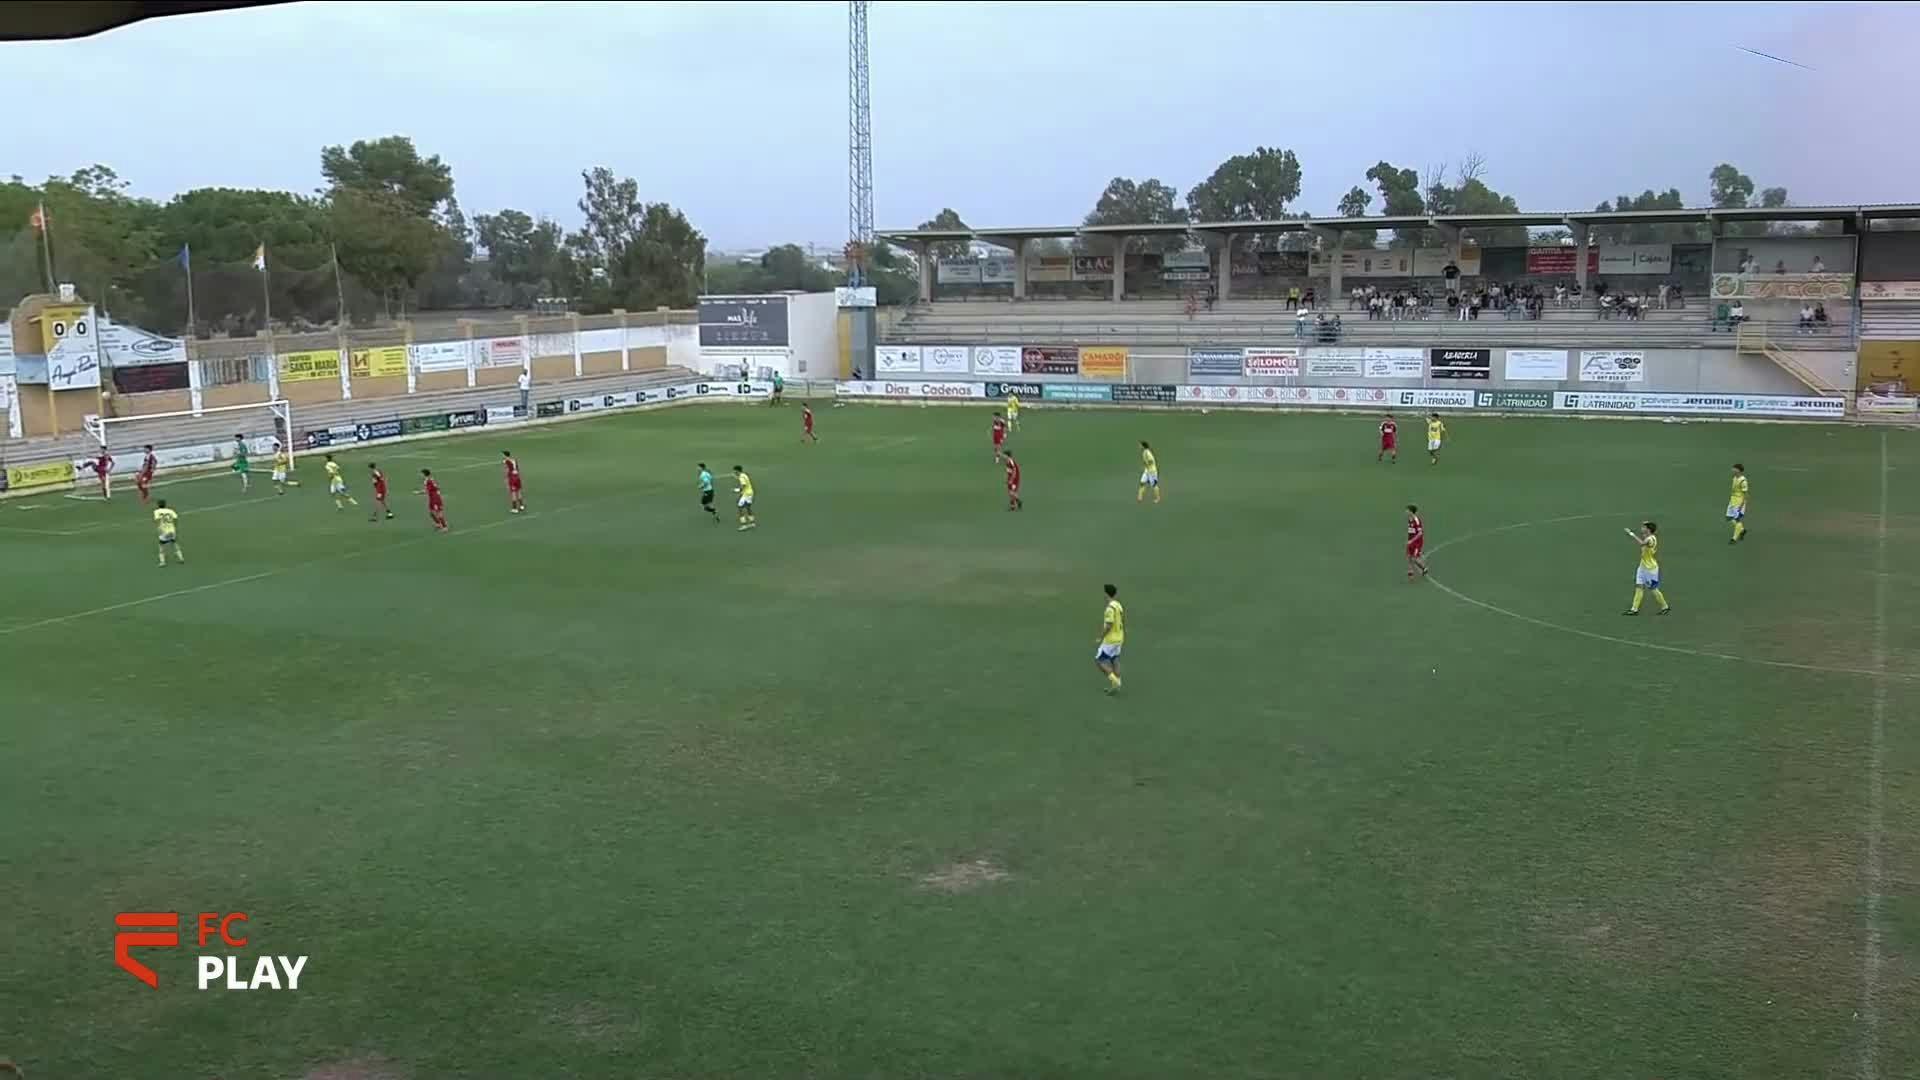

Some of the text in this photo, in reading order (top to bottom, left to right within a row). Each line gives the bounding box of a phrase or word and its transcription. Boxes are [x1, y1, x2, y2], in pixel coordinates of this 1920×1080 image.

[55, 321, 86, 336] 0 0
[921, 384, 973, 396] Cadenas
[1000, 383, 1040, 395] Gravina
